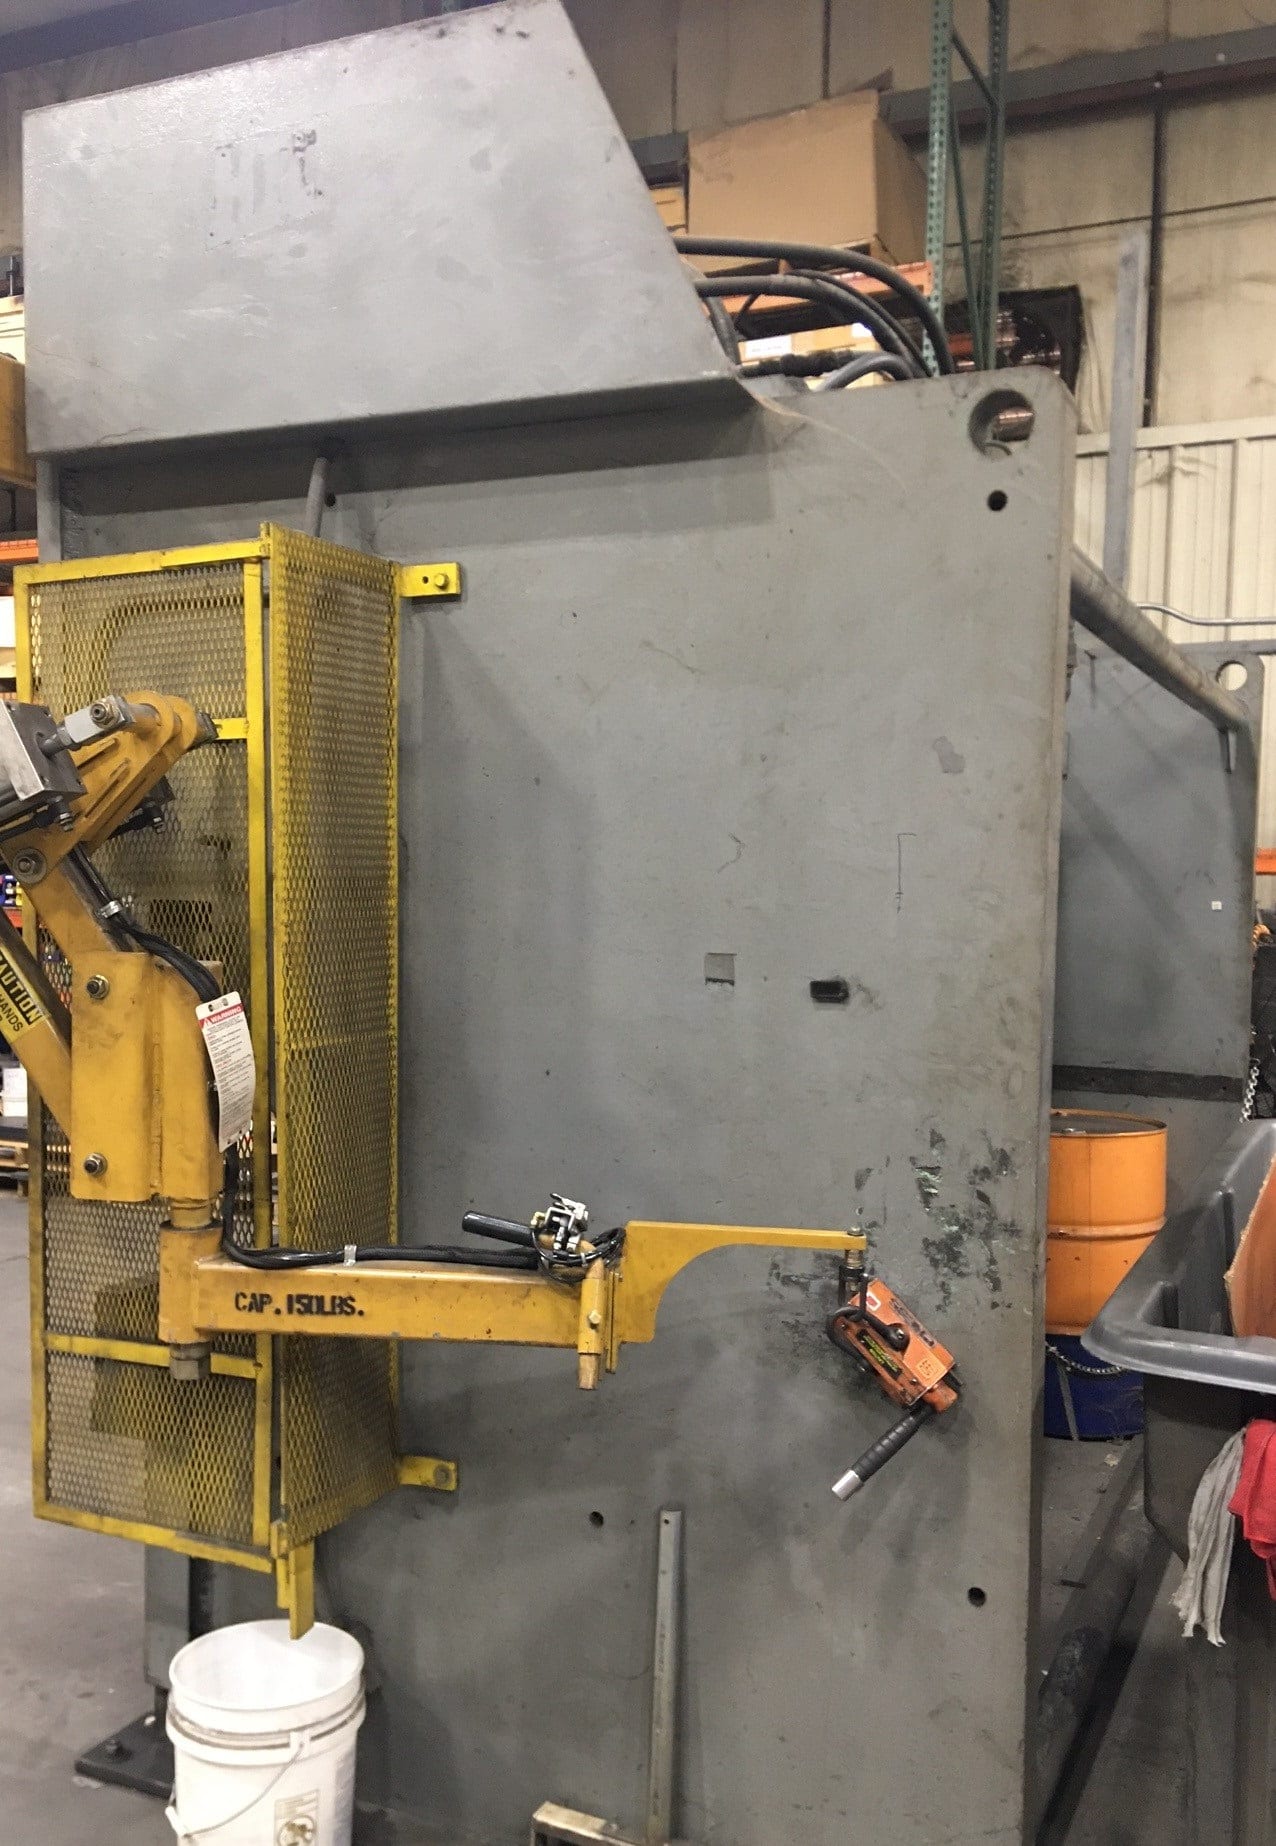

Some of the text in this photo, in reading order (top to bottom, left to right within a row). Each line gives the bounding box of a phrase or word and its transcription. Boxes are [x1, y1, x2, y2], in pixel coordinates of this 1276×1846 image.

[0, 953, 42, 1024] AUTION
[210, 1004, 243, 1023] WARNING
[234, 1291, 281, 1315] CAP.
